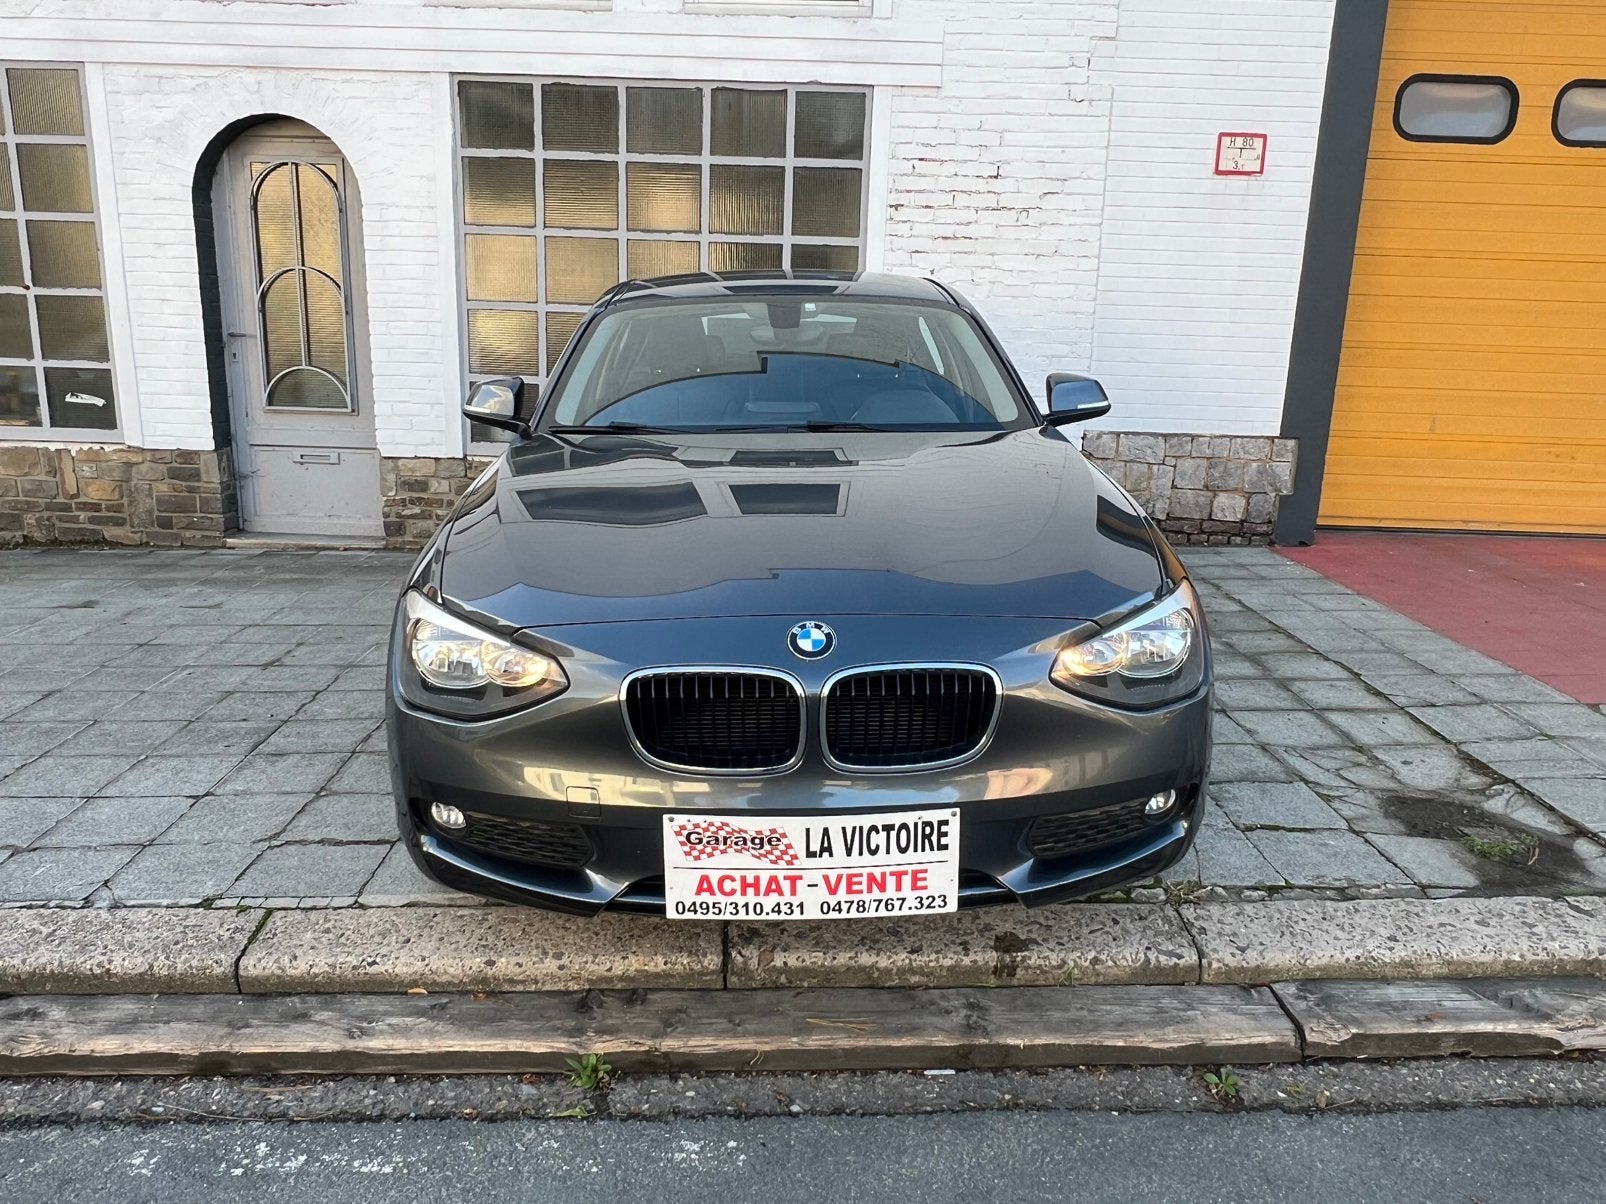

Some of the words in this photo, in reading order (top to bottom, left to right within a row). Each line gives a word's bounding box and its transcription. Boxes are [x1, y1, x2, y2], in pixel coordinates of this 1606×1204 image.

[1229, 137, 1237, 147] H
[1242, 137, 1254, 147] 80
[791, 622, 830, 635] BMW
[685, 830, 783, 851] Garage
[805, 827, 834, 859] LA
[841, 819, 950, 857] VICTOIRE
[675, 900, 805, 916] 0495/310.431
[820, 895, 948, 915] 0478/767.323
